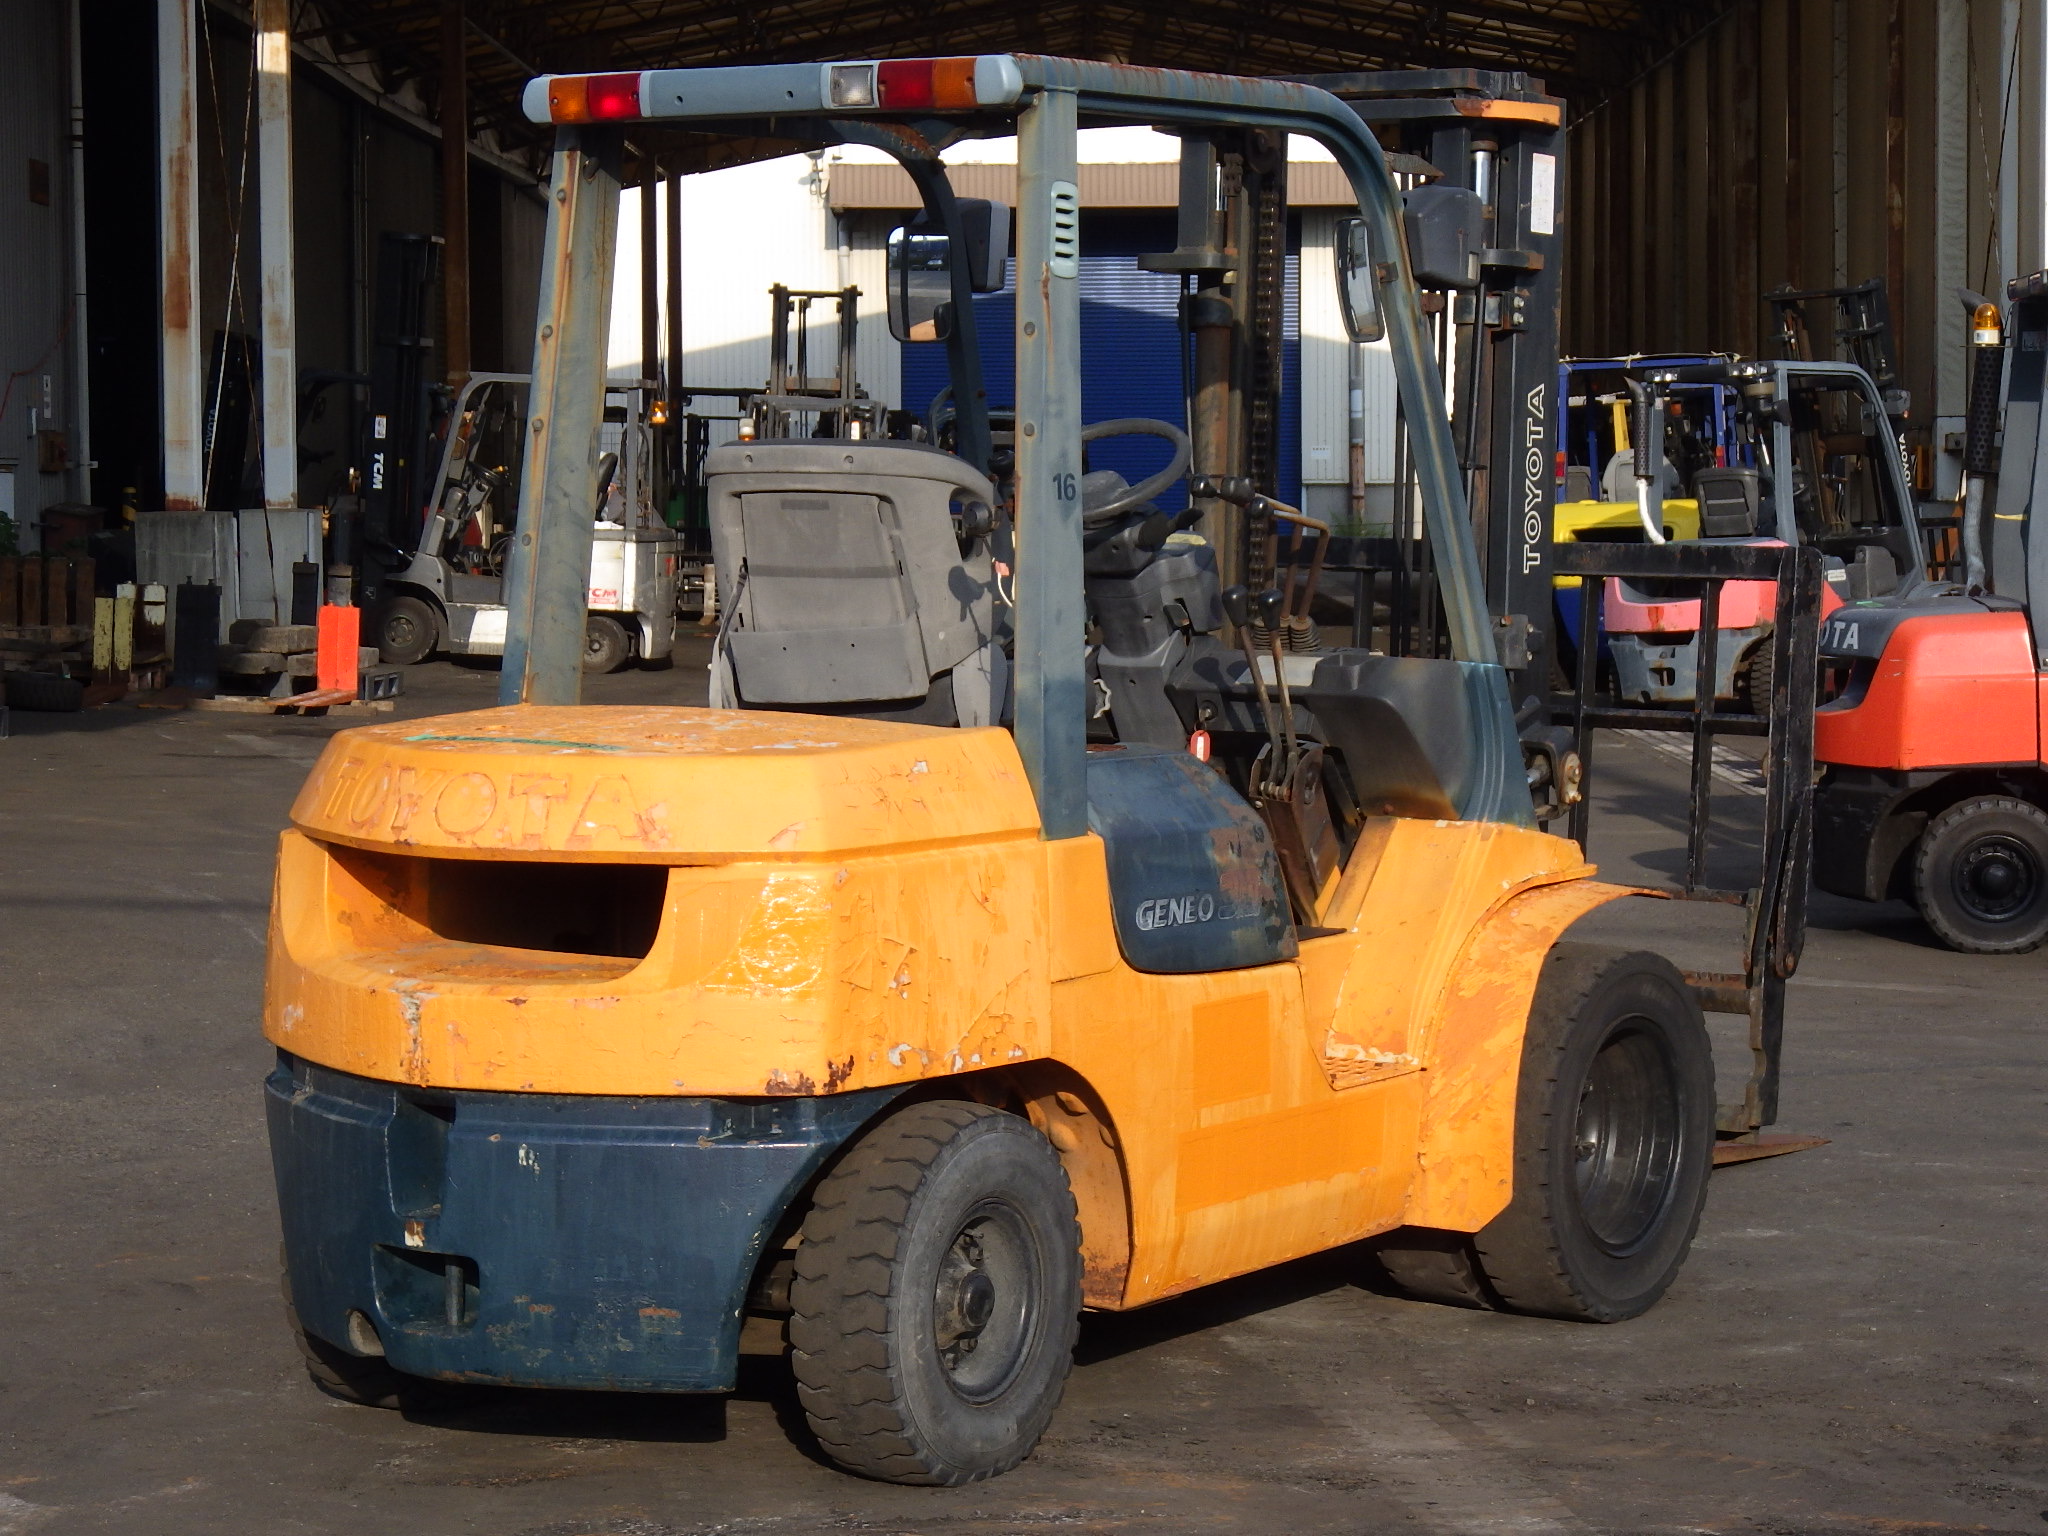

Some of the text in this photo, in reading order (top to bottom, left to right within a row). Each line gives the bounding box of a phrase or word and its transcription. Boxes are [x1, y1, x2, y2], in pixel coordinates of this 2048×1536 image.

[372, 452, 384, 490] TCM
[1052, 472, 1077, 502] 16
[1523, 382, 1545, 574] TOYOTA
[588, 587, 618, 598] CM
[322, 756, 656, 844] TOYOTA
[1134, 892, 1215, 931] GENEO
